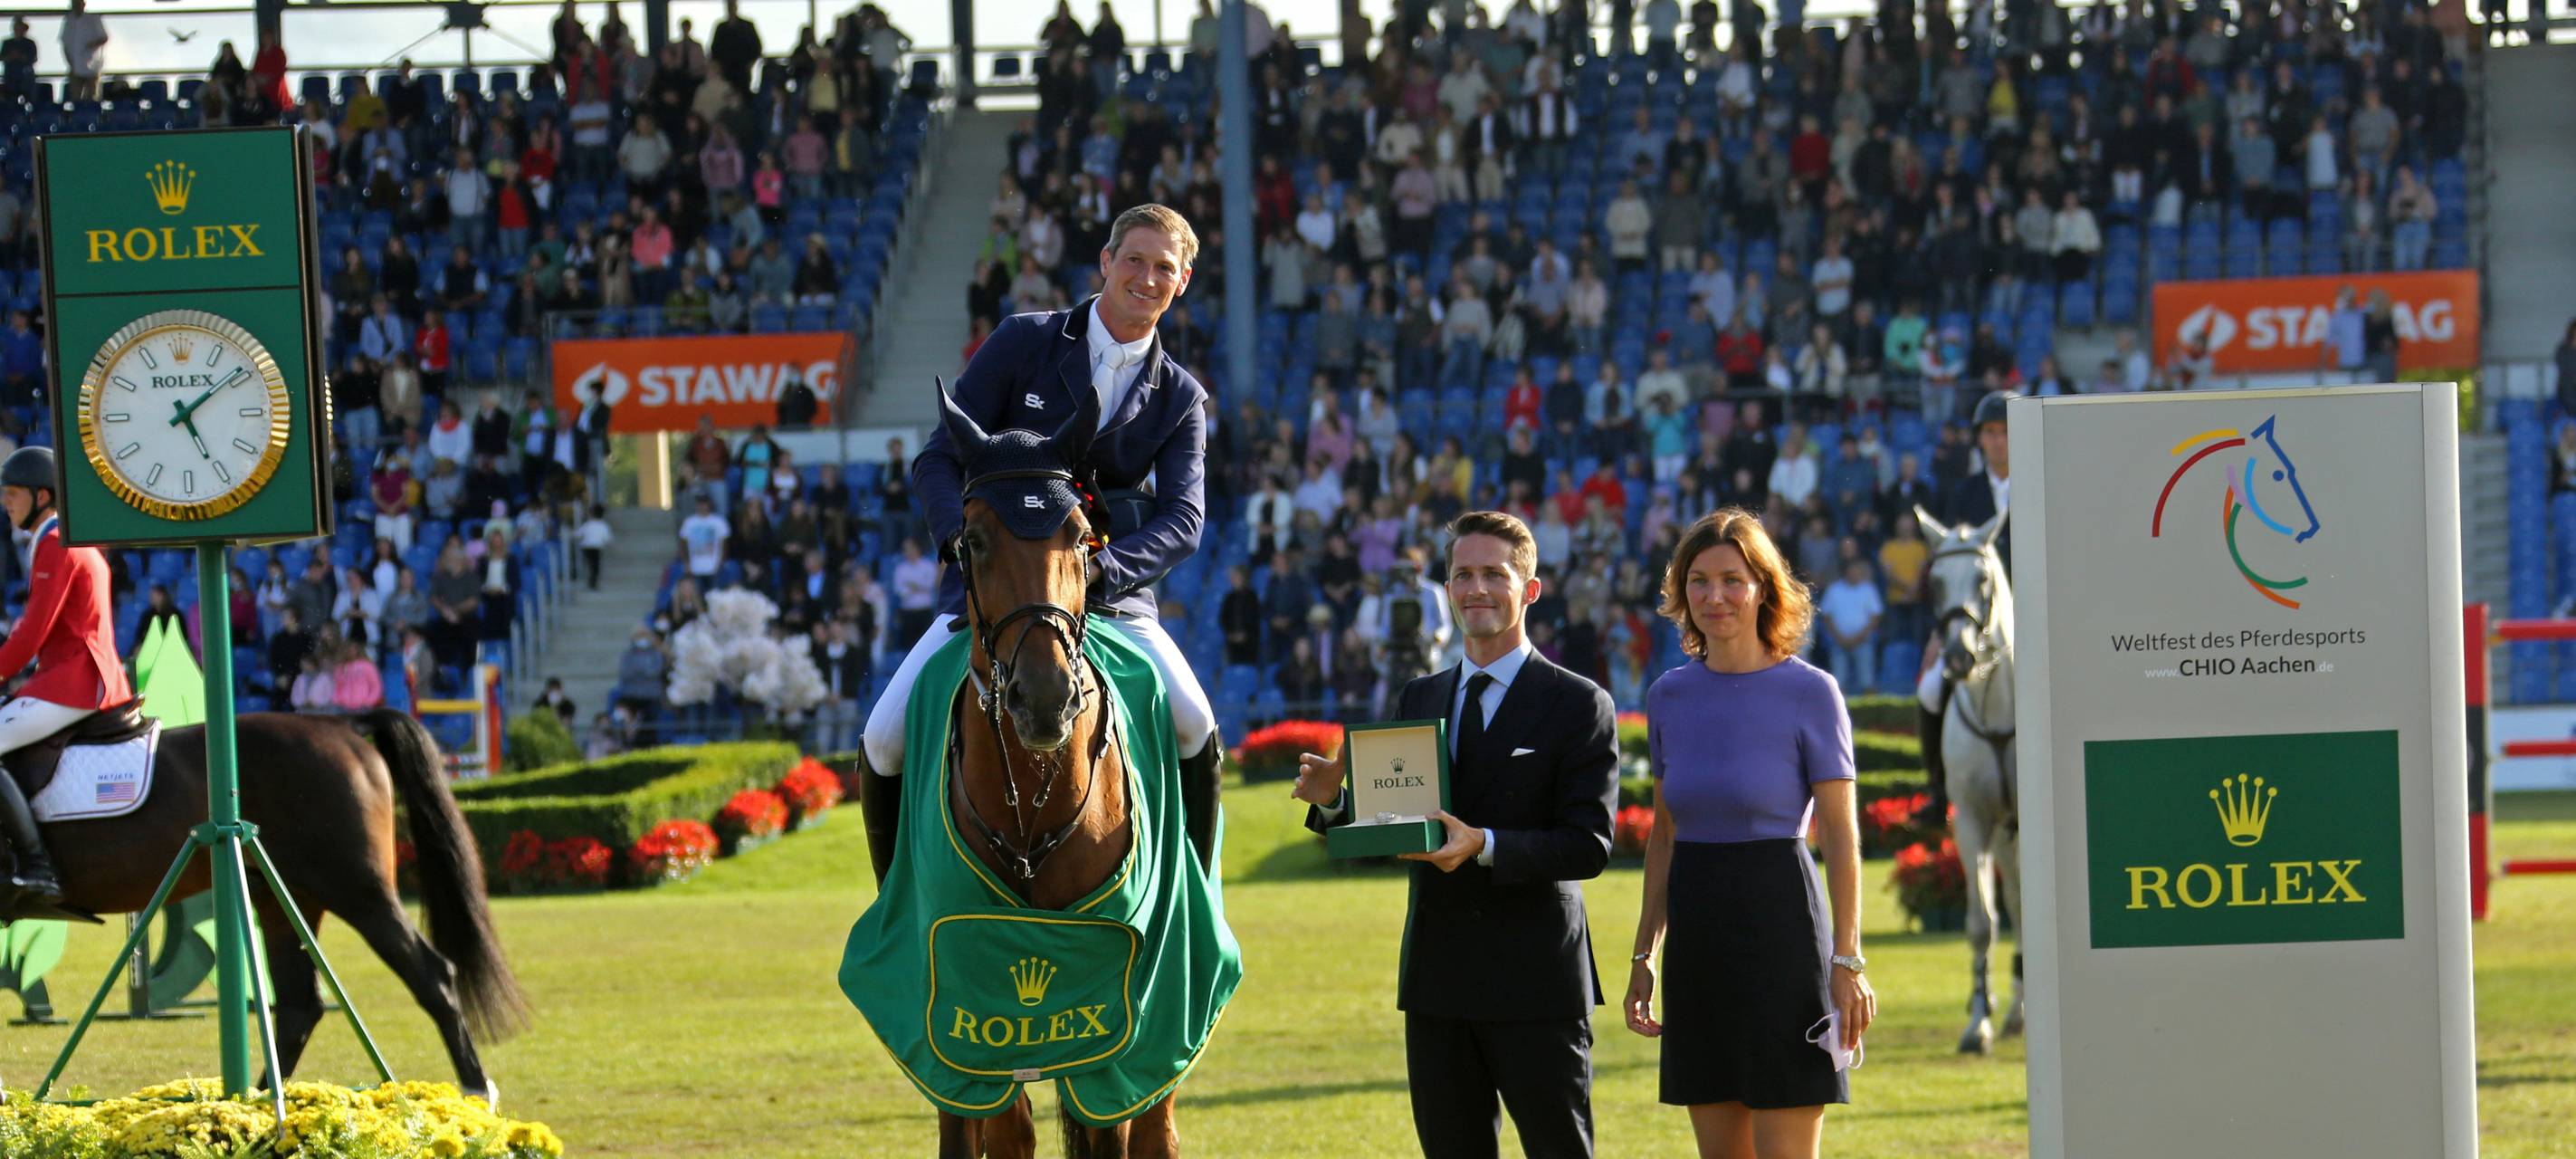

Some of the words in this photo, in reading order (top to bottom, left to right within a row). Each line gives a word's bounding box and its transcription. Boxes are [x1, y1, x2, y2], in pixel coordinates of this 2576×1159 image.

[85, 224, 264, 263] ROLEX
[2245, 299, 2455, 350] STAAG
[151, 374, 214, 388] ROLEX
[2112, 634, 2196, 652] Weltfest
[2201, 632, 2234, 648] des
[2240, 628, 2365, 648] Pferdesports
[1374, 776, 1425, 789] ROLEX
[2124, 859, 2366, 909] ROLEX
[949, 1004, 1110, 1047] ROLEX
